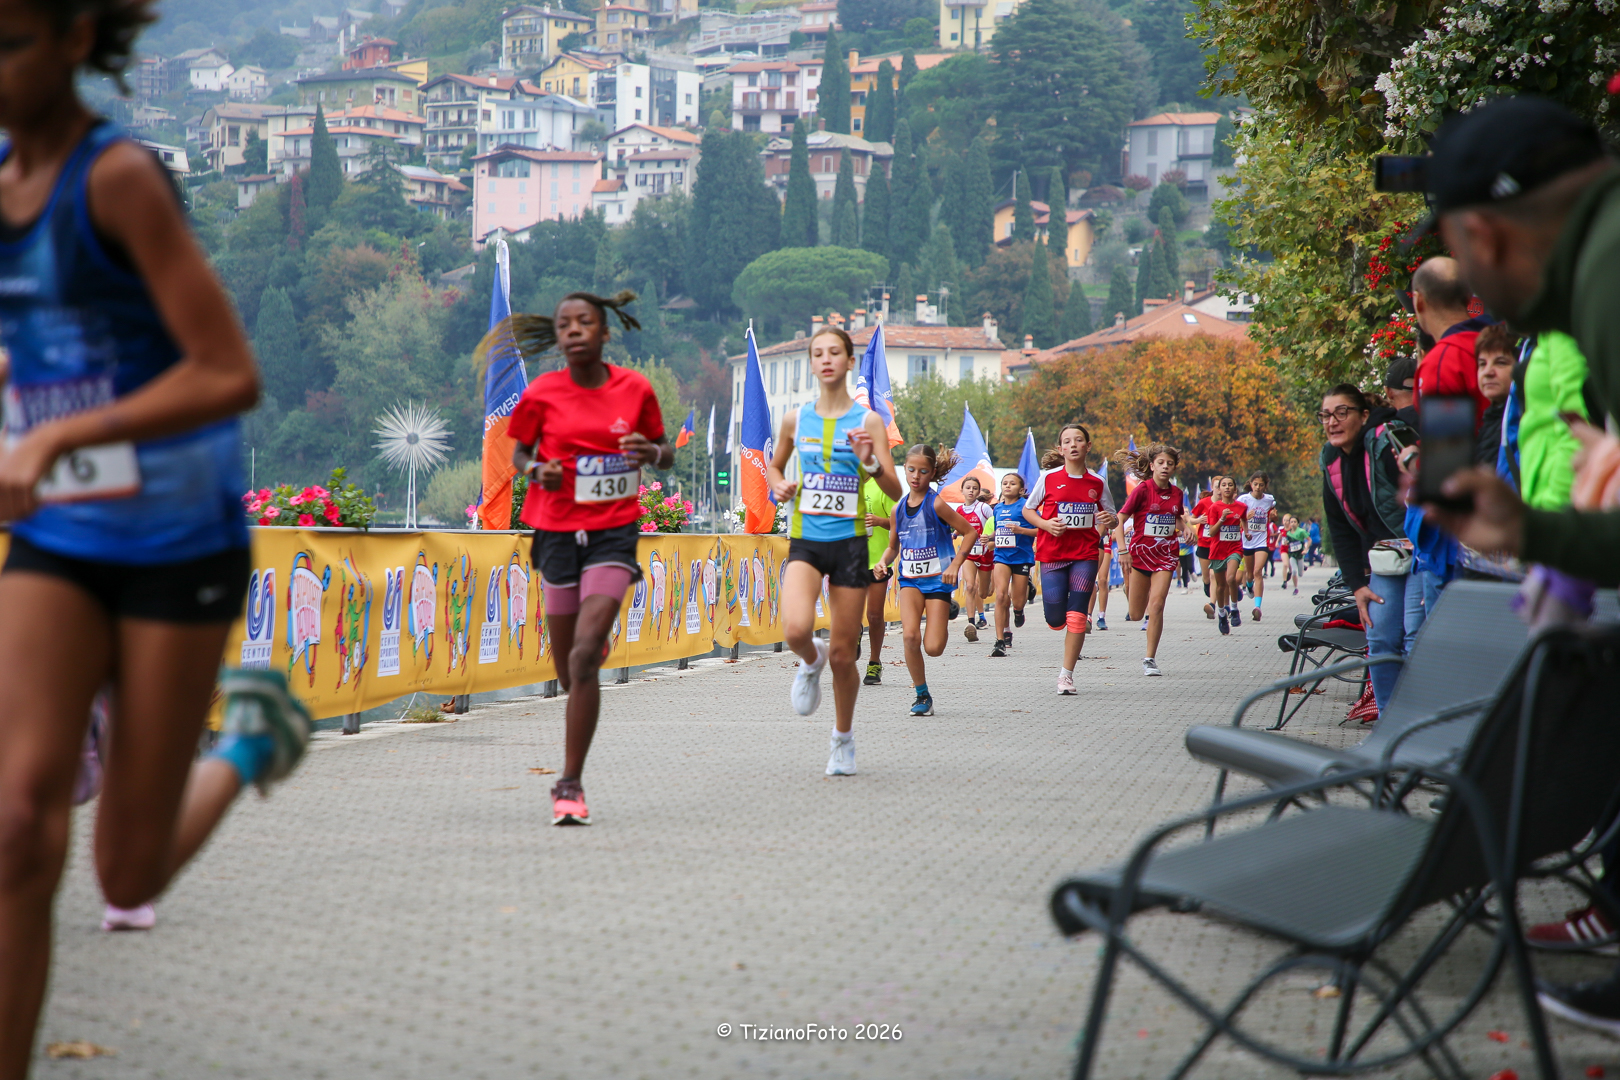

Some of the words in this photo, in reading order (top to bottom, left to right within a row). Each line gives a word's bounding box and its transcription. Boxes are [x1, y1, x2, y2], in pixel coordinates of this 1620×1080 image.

[826, 475, 859, 483] CENTRO
[591, 477, 627, 497] 430
[812, 493, 845, 511] 228
[1065, 515, 1086, 527] 201
[1152, 525, 1170, 535] 173
[996, 536, 1010, 545] 576
[1224, 532, 1238, 540] 437
[909, 561, 930, 574] 457
[481, 627, 500, 637] CENTRO
[380, 635, 400, 647] CENTRO
[242, 647, 272, 659] CENTRO
[480, 646, 499, 656] ITALIANO
